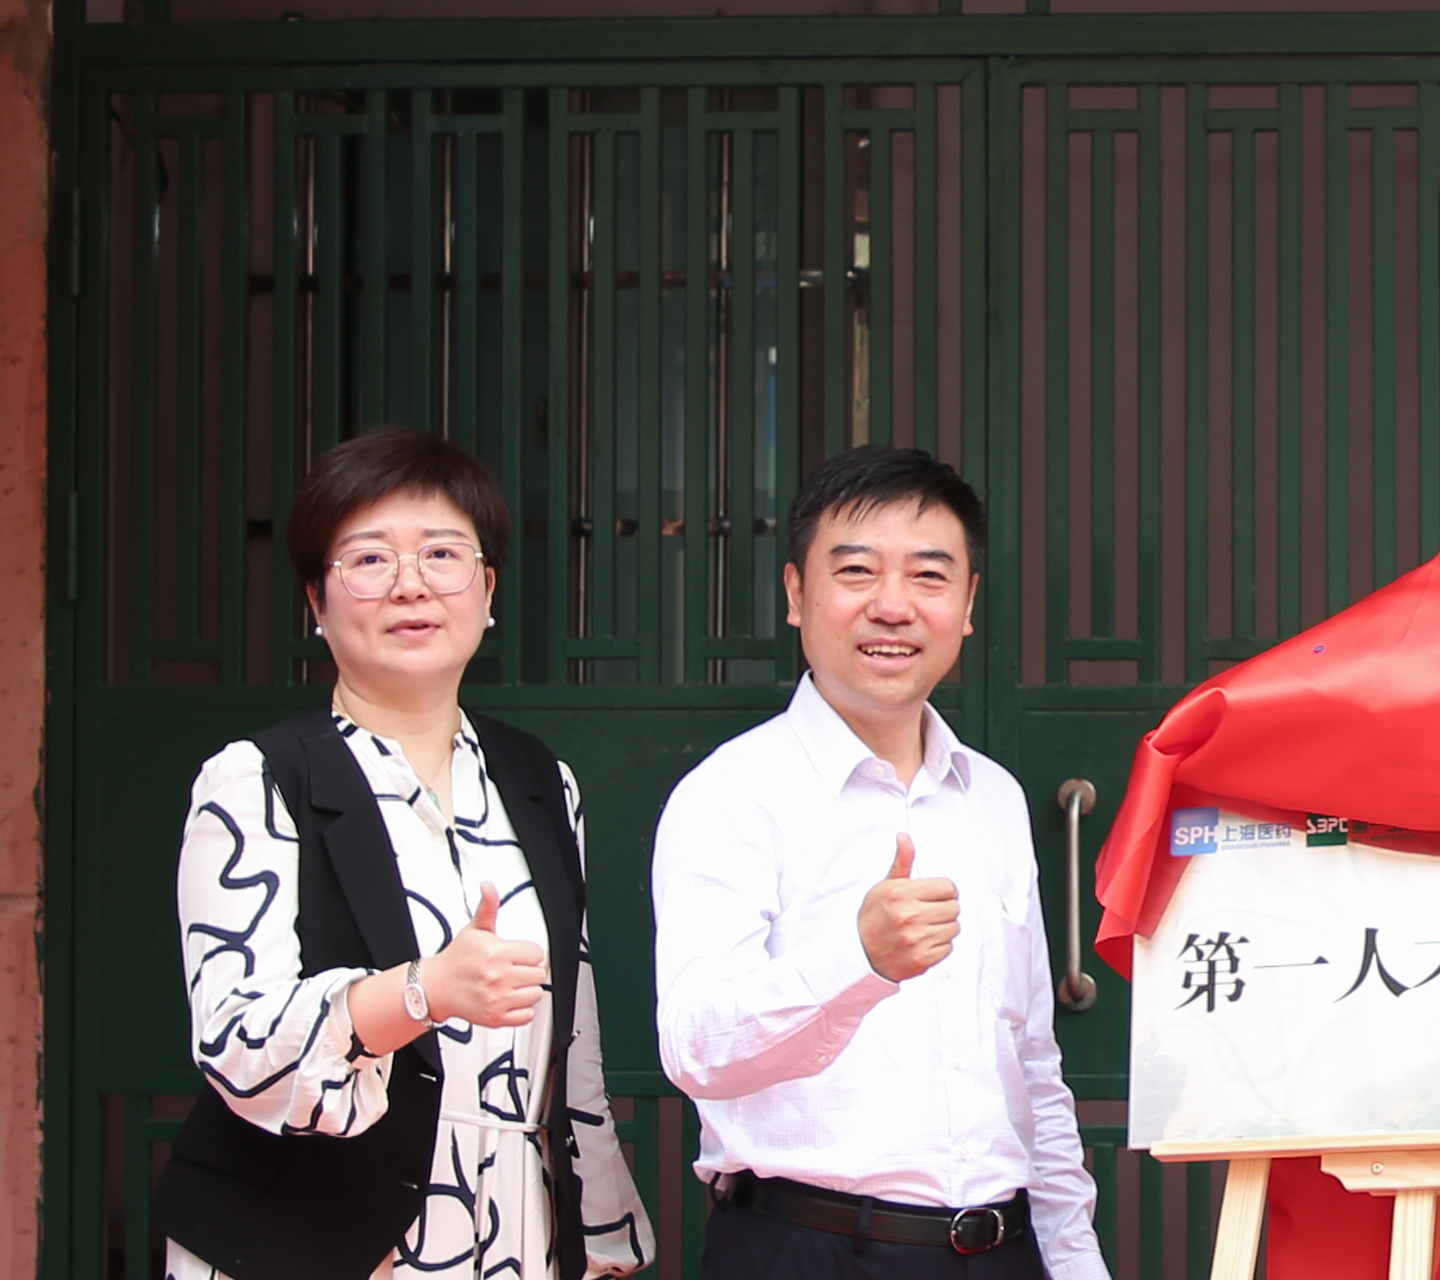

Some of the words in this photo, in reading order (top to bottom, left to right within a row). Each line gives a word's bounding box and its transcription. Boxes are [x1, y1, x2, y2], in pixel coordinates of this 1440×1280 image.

[1174, 825, 1219, 846] SPH
[1221, 823, 1292, 842] 上海医药
